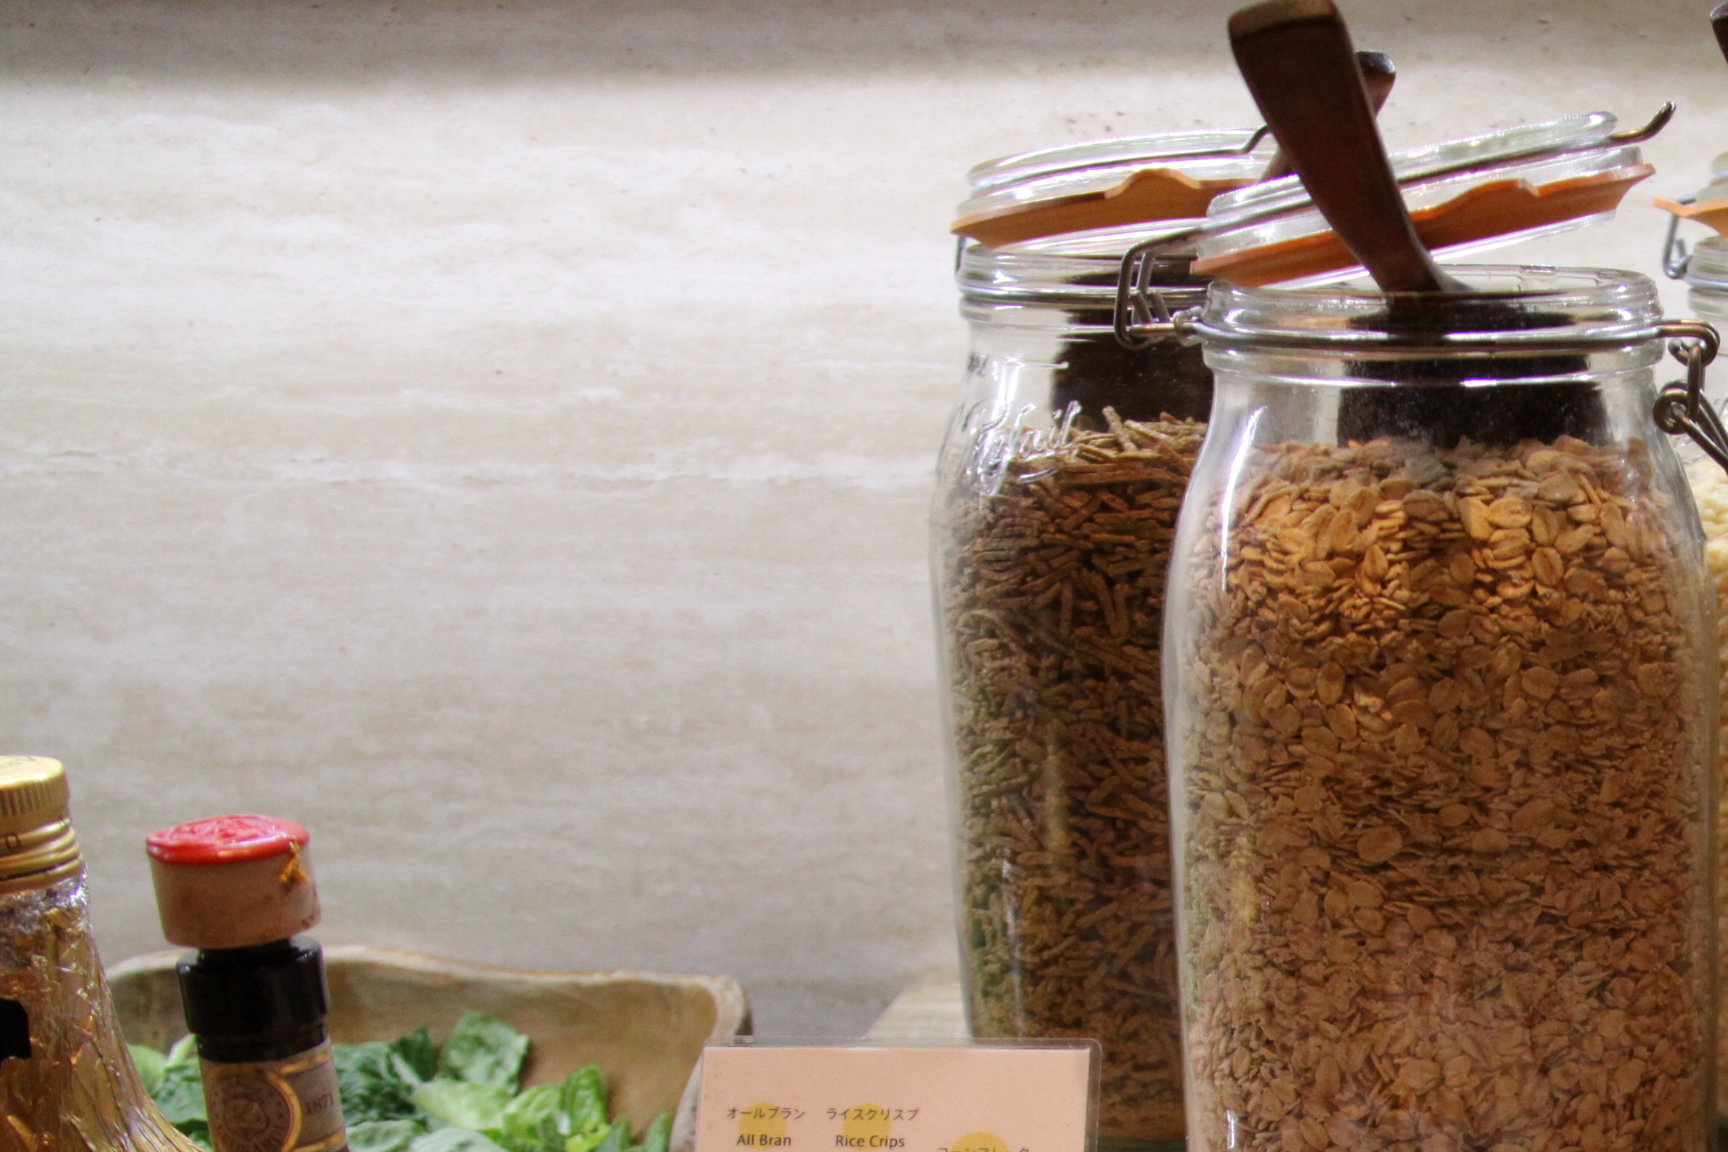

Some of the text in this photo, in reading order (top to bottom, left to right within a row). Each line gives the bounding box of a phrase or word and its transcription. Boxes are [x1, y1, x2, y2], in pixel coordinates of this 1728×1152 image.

[736, 1134, 792, 1147] All Bran
[835, 1134, 905, 1150] Rice Crips
